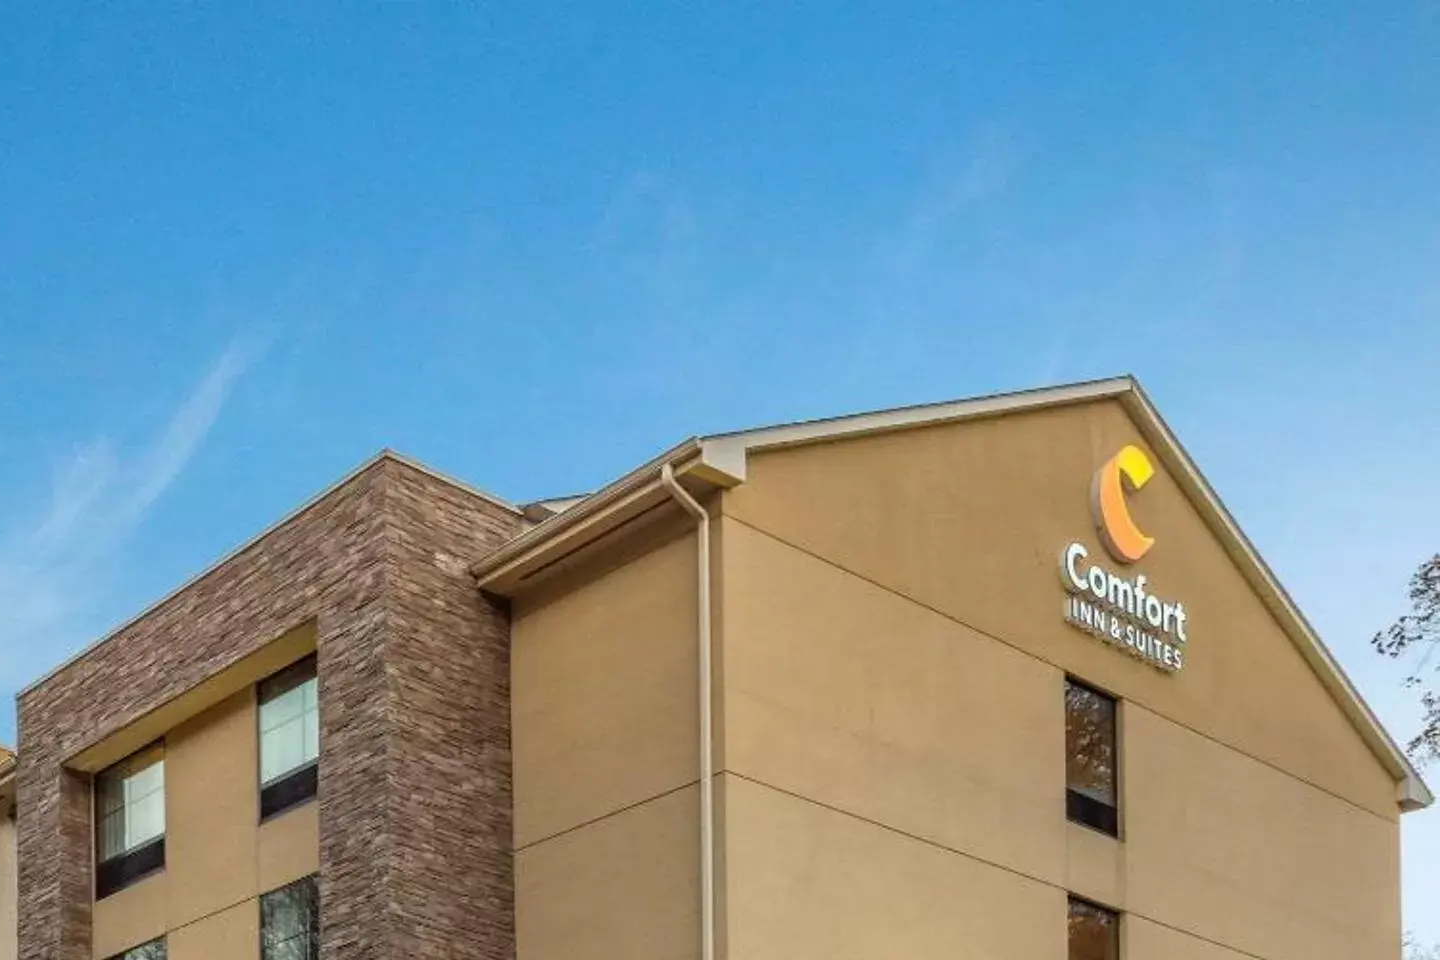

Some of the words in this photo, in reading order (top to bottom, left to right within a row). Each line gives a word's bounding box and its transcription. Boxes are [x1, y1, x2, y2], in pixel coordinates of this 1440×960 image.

[1066, 543, 1187, 642] Comfort
[1070, 599, 1105, 632] INN
[1110, 618, 1122, 640] &
[1125, 625, 1183, 669] SUITES
